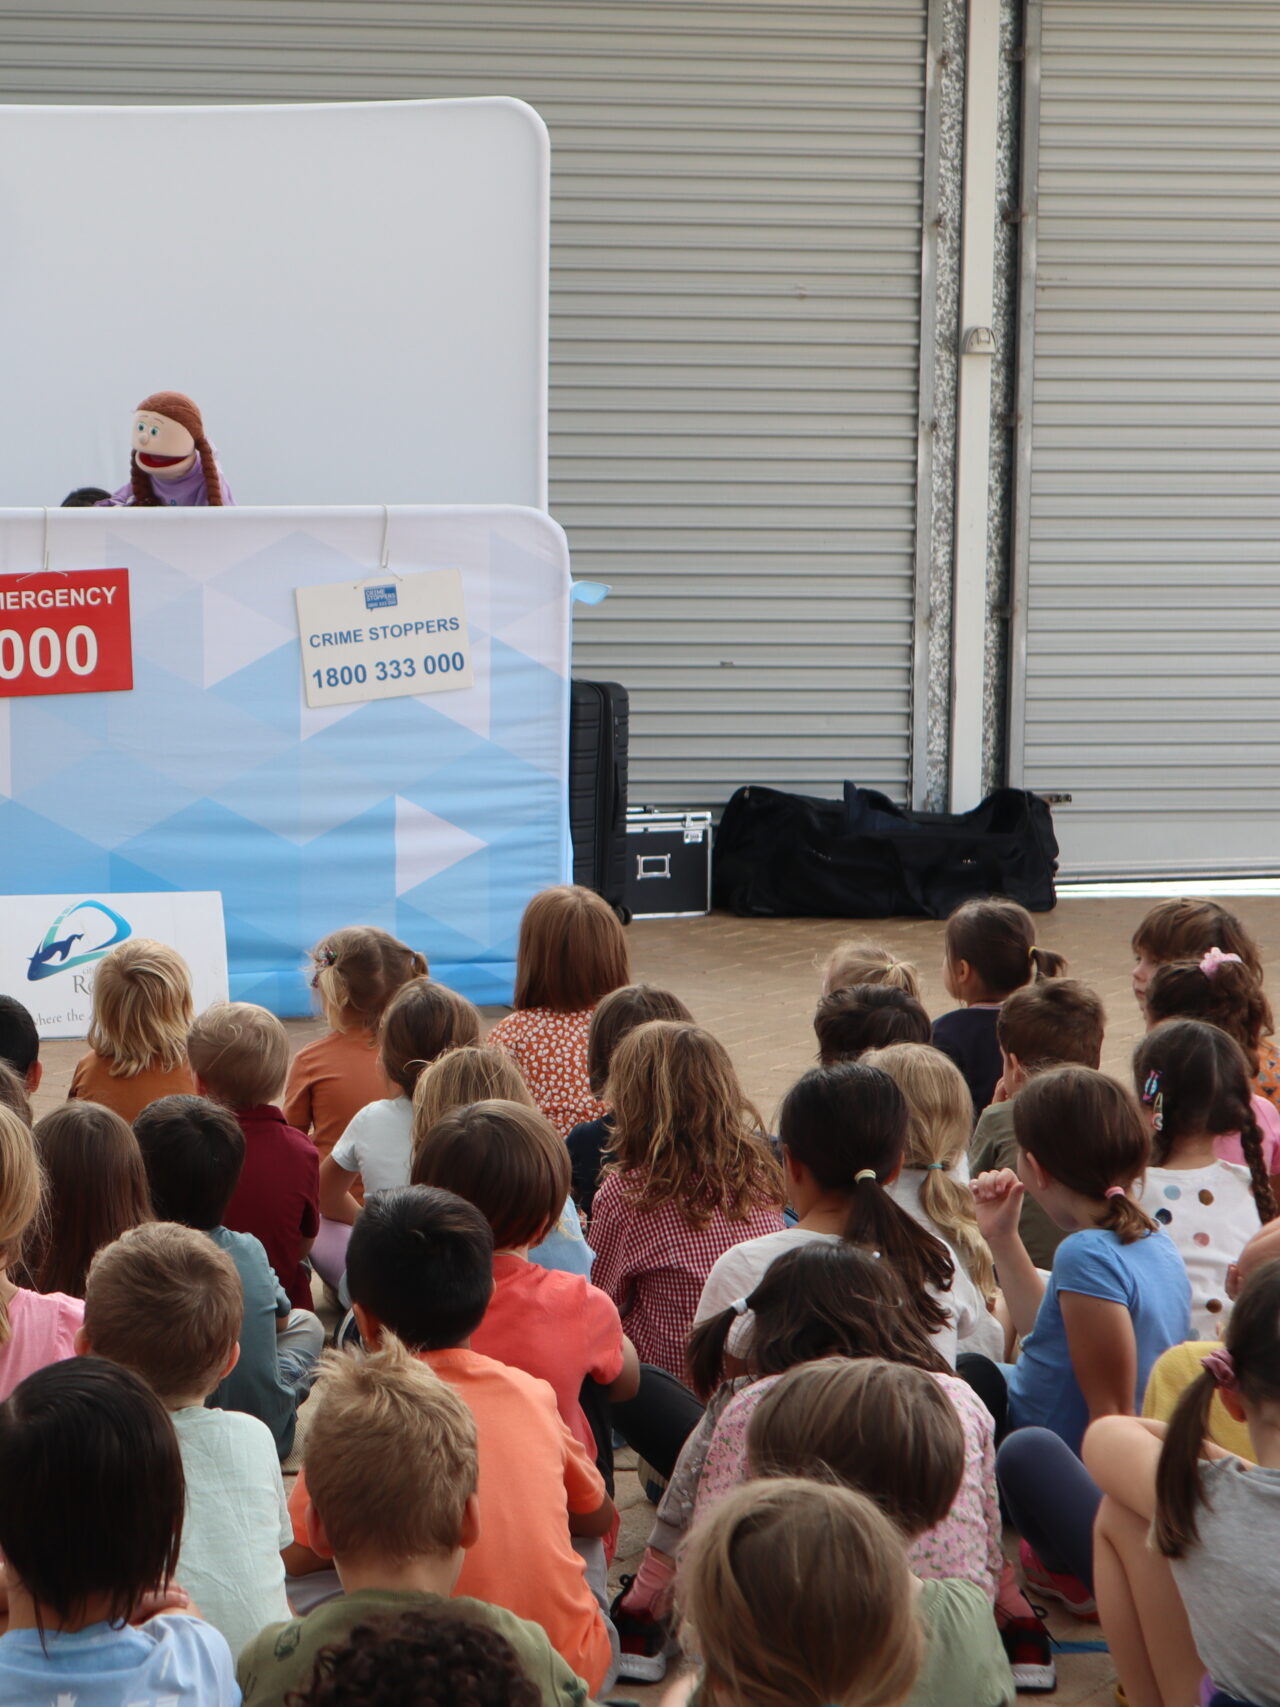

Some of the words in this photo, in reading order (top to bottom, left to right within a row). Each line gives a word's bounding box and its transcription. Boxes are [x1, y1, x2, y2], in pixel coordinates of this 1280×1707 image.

[309, 628, 364, 648] CRIME
[369, 617, 460, 641] STOPPERS
[312, 664, 368, 689] 1800
[374, 658, 416, 681] 333
[423, 652, 465, 675] 000
[66, 1008, 86, 1023] the
